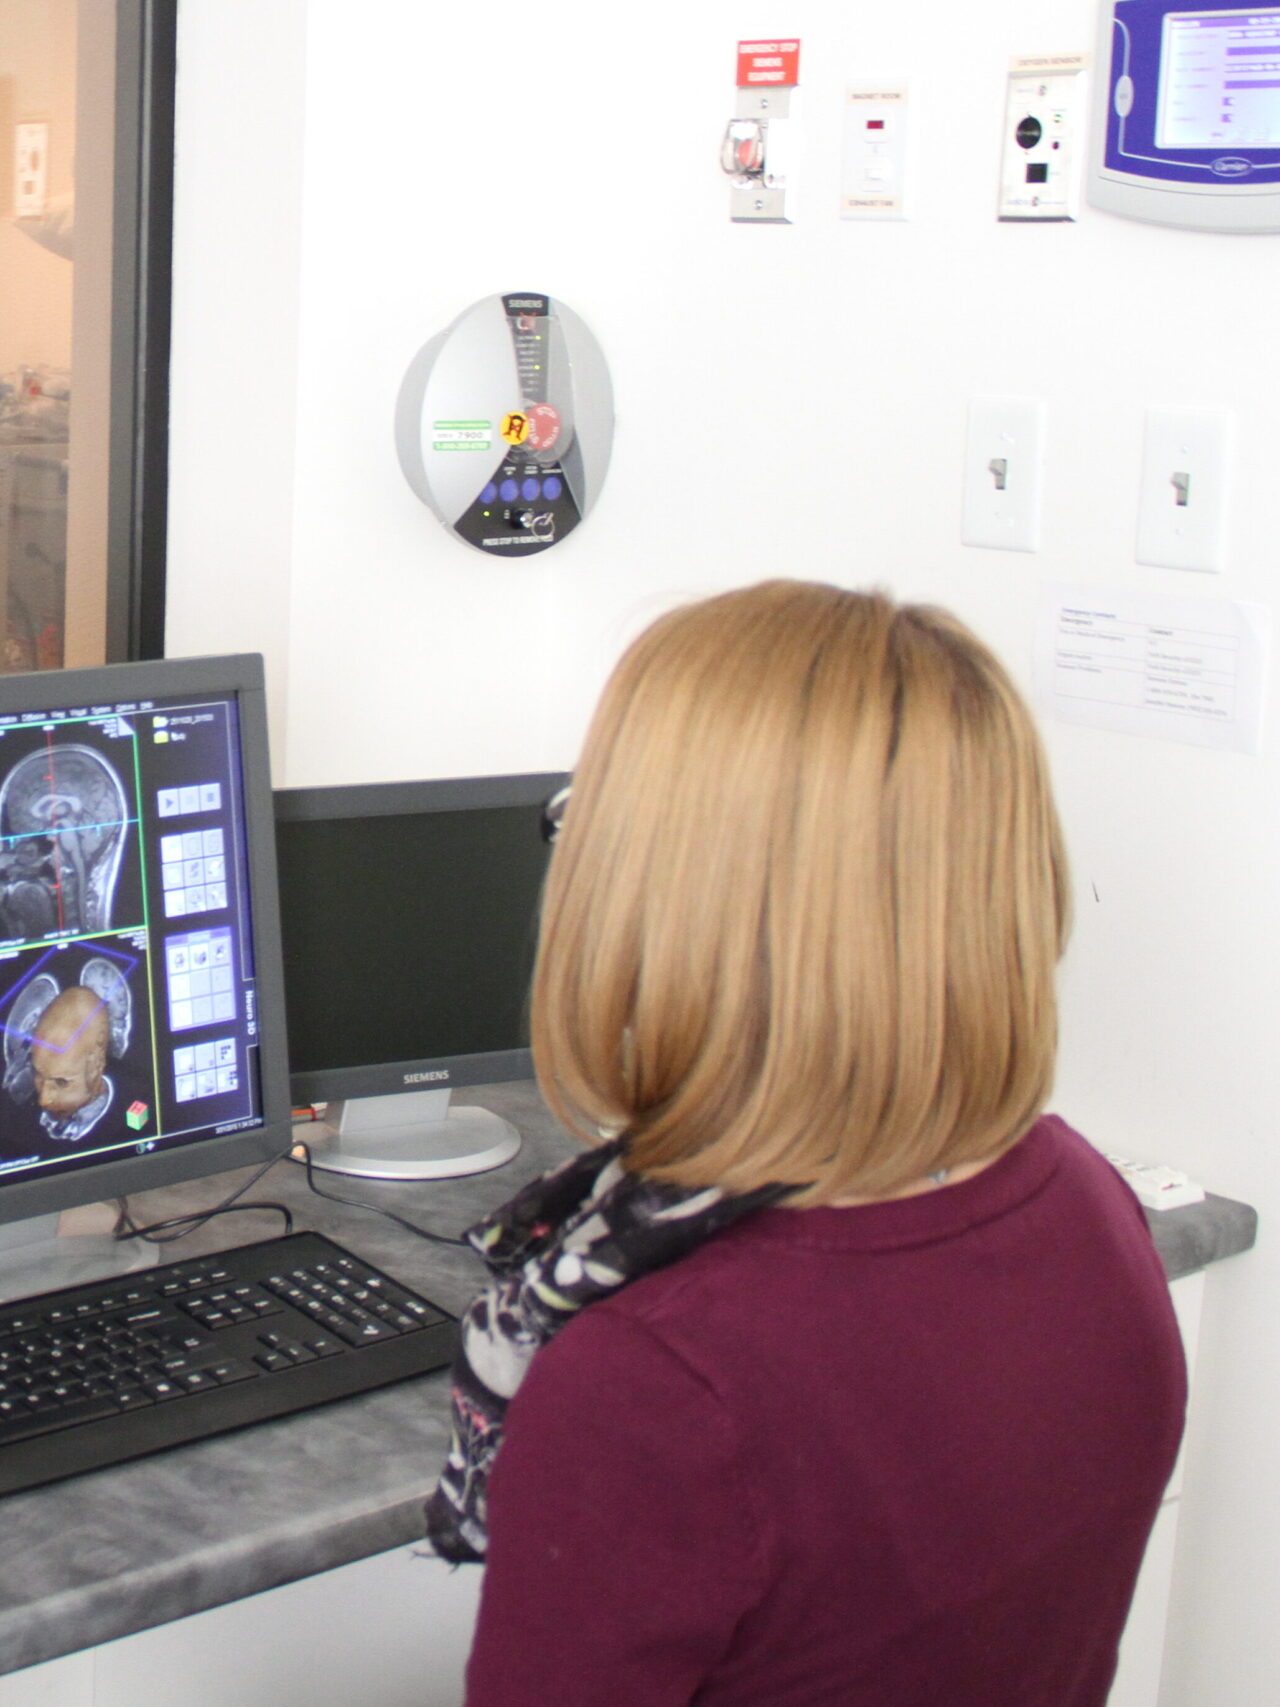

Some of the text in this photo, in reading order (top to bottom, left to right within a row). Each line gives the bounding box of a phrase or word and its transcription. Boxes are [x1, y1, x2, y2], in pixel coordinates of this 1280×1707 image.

[508, 298, 544, 309] SIEMENS
[245, 990, 256, 1036] Neuro 3D
[403, 1069, 450, 1084] SIEMENS
